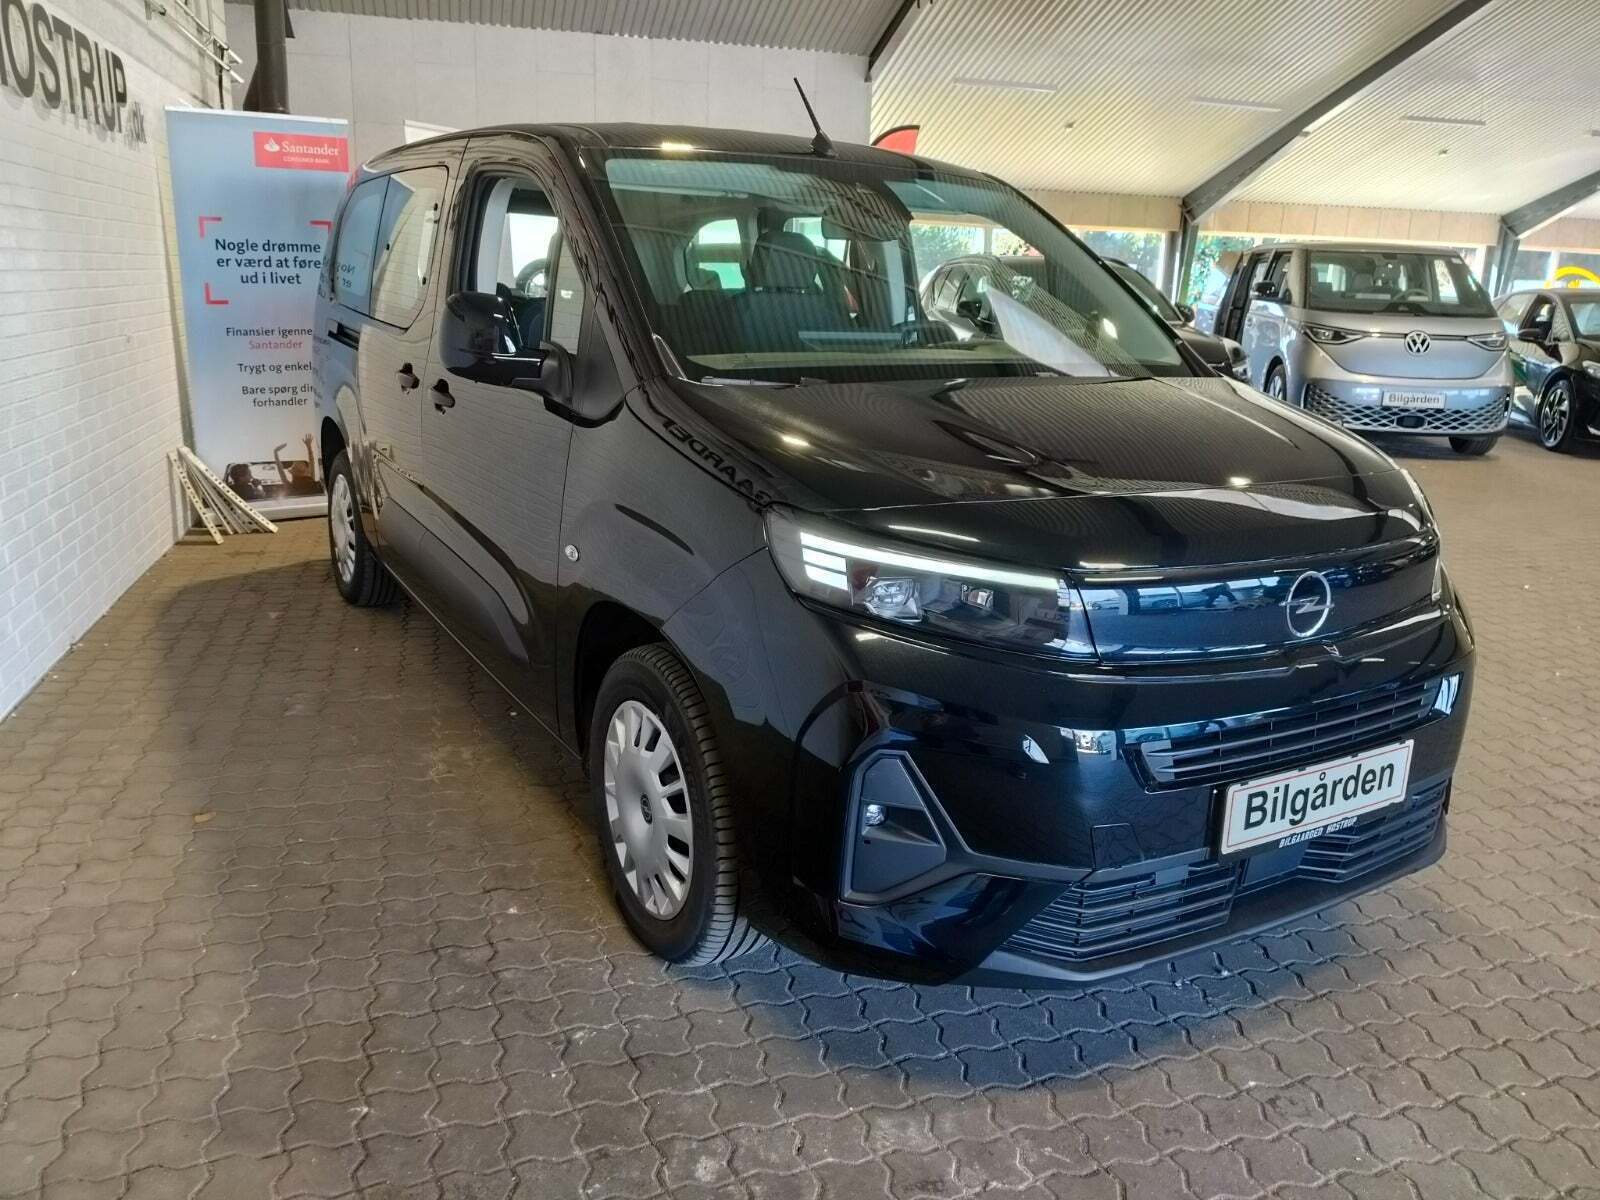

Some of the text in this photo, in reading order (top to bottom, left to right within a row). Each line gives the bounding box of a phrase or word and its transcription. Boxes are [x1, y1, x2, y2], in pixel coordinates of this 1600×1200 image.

[0, 0, 127, 133] OSTRUP
[281, 141, 340, 156] Santander
[215, 238, 321, 255] Nogle drømme
[216, 257, 232, 268] er
[235, 255, 272, 268] værd
[276, 256, 290, 269] at
[293, 256, 321, 269] føre
[240, 271, 302, 285] ud i livet
[226, 327, 313, 339] Finansier igenne
[248, 339, 304, 350] Santander
[237, 361, 313, 375] Trygt og enkel
[241, 385, 267, 395] Bare
[268, 385, 299, 397] spørg
[253, 397, 309, 408] forhandler
[1388, 393, 1440, 406] Bilgården
[1243, 762, 1395, 831] Bilgården
